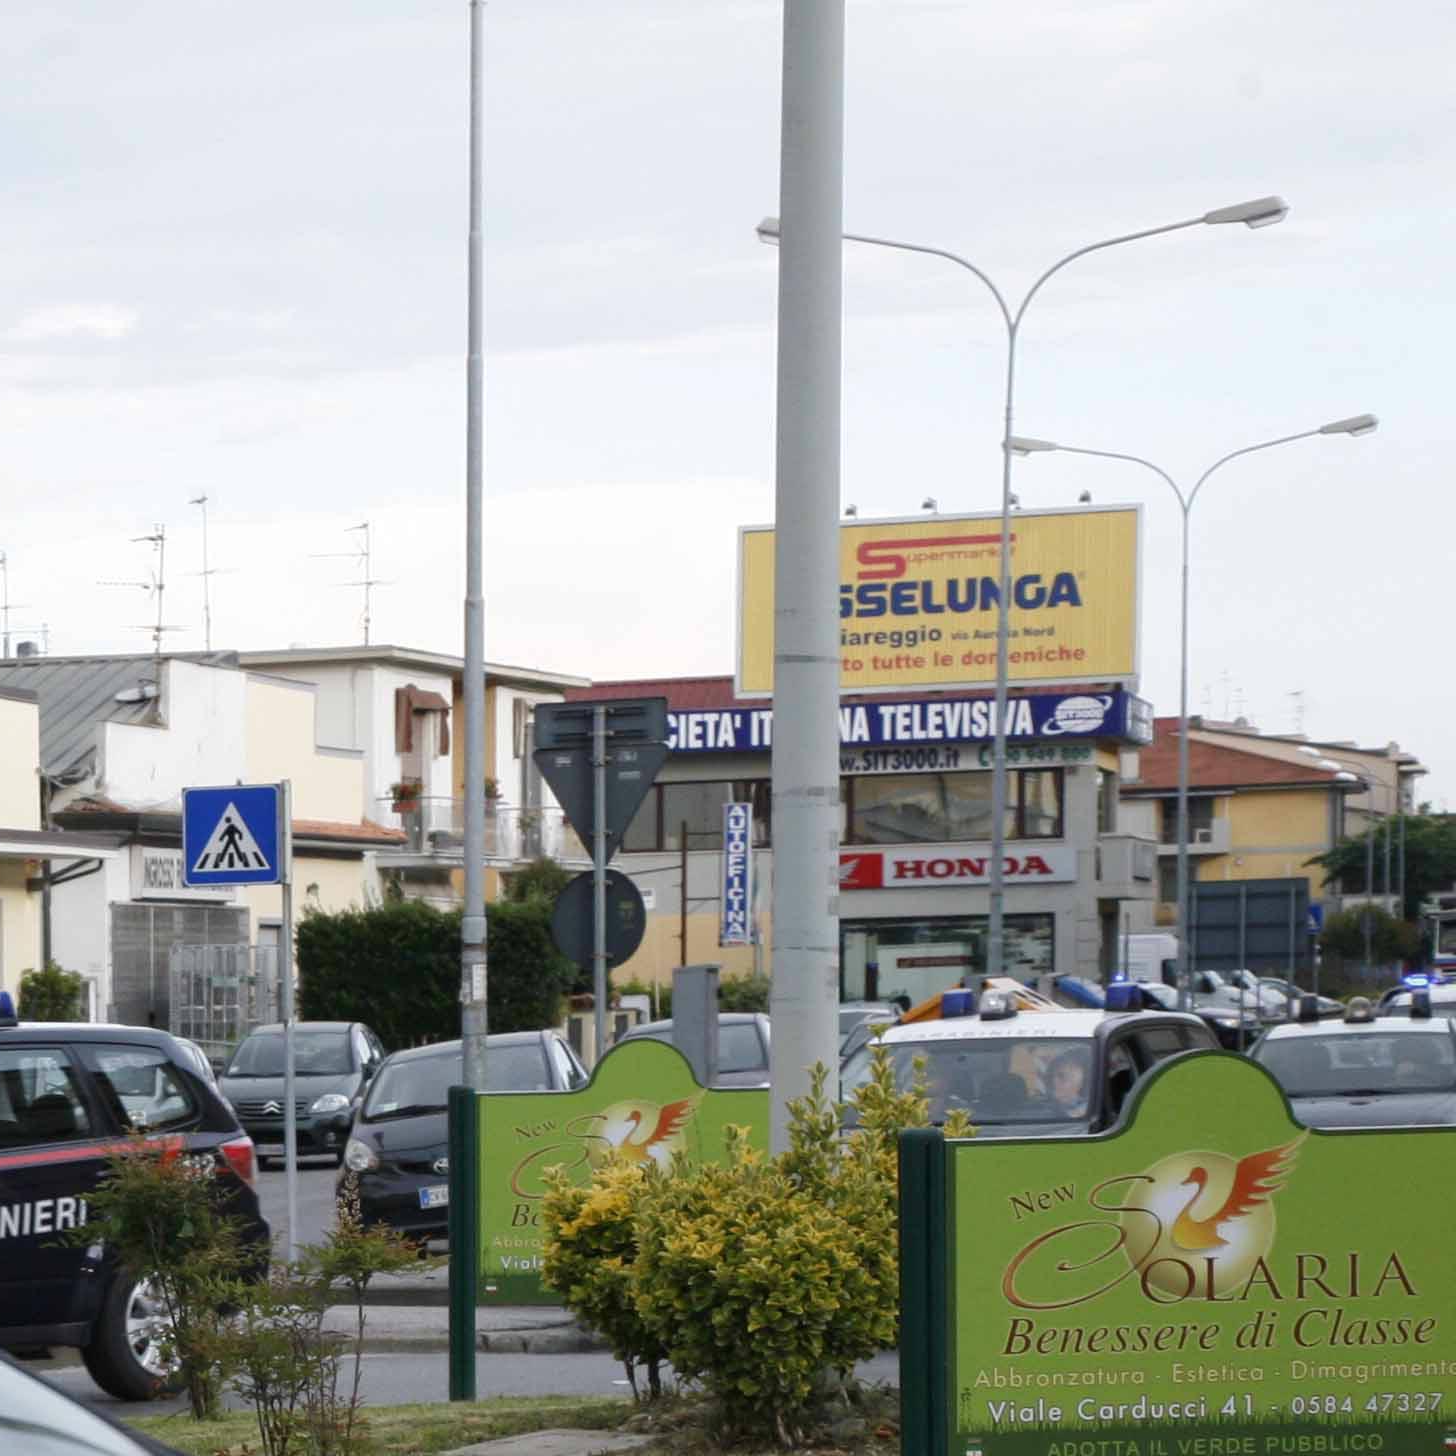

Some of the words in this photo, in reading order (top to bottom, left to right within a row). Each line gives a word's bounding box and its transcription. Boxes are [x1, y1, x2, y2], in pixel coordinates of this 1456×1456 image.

[840, 626, 942, 649] iareggio
[872, 653, 926, 671] tutte
[933, 651, 954, 667] le
[727, 805, 746, 938] AUTOFFICINA
[892, 855, 1054, 880] HONDA
[514, 1118, 558, 1141] New
[1008, 1182, 1077, 1220] New
[1002, 1175, 1420, 1311] SOLARIA
[1002, 1316, 1221, 1356] Benessere
[1235, 1310, 1278, 1349] di
[1292, 1308, 1437, 1348] Classe
[975, 1365, 1145, 1389] Abbronzatura
[1172, 1362, 1265, 1385] Estetica
[988, 1397, 1063, 1425] Viale
[1078, 1394, 1207, 1422] Carducci
[1221, 1394, 1256, 1418] 41
[1291, 1394, 1354, 1417] 0584
[1366, 1392, 1444, 1415] 47327
[1150, 1439, 1168, 1456] IL
[1178, 1436, 1257, 1456] VERDE
[1266, 1433, 1385, 1454] PUBBLICO
